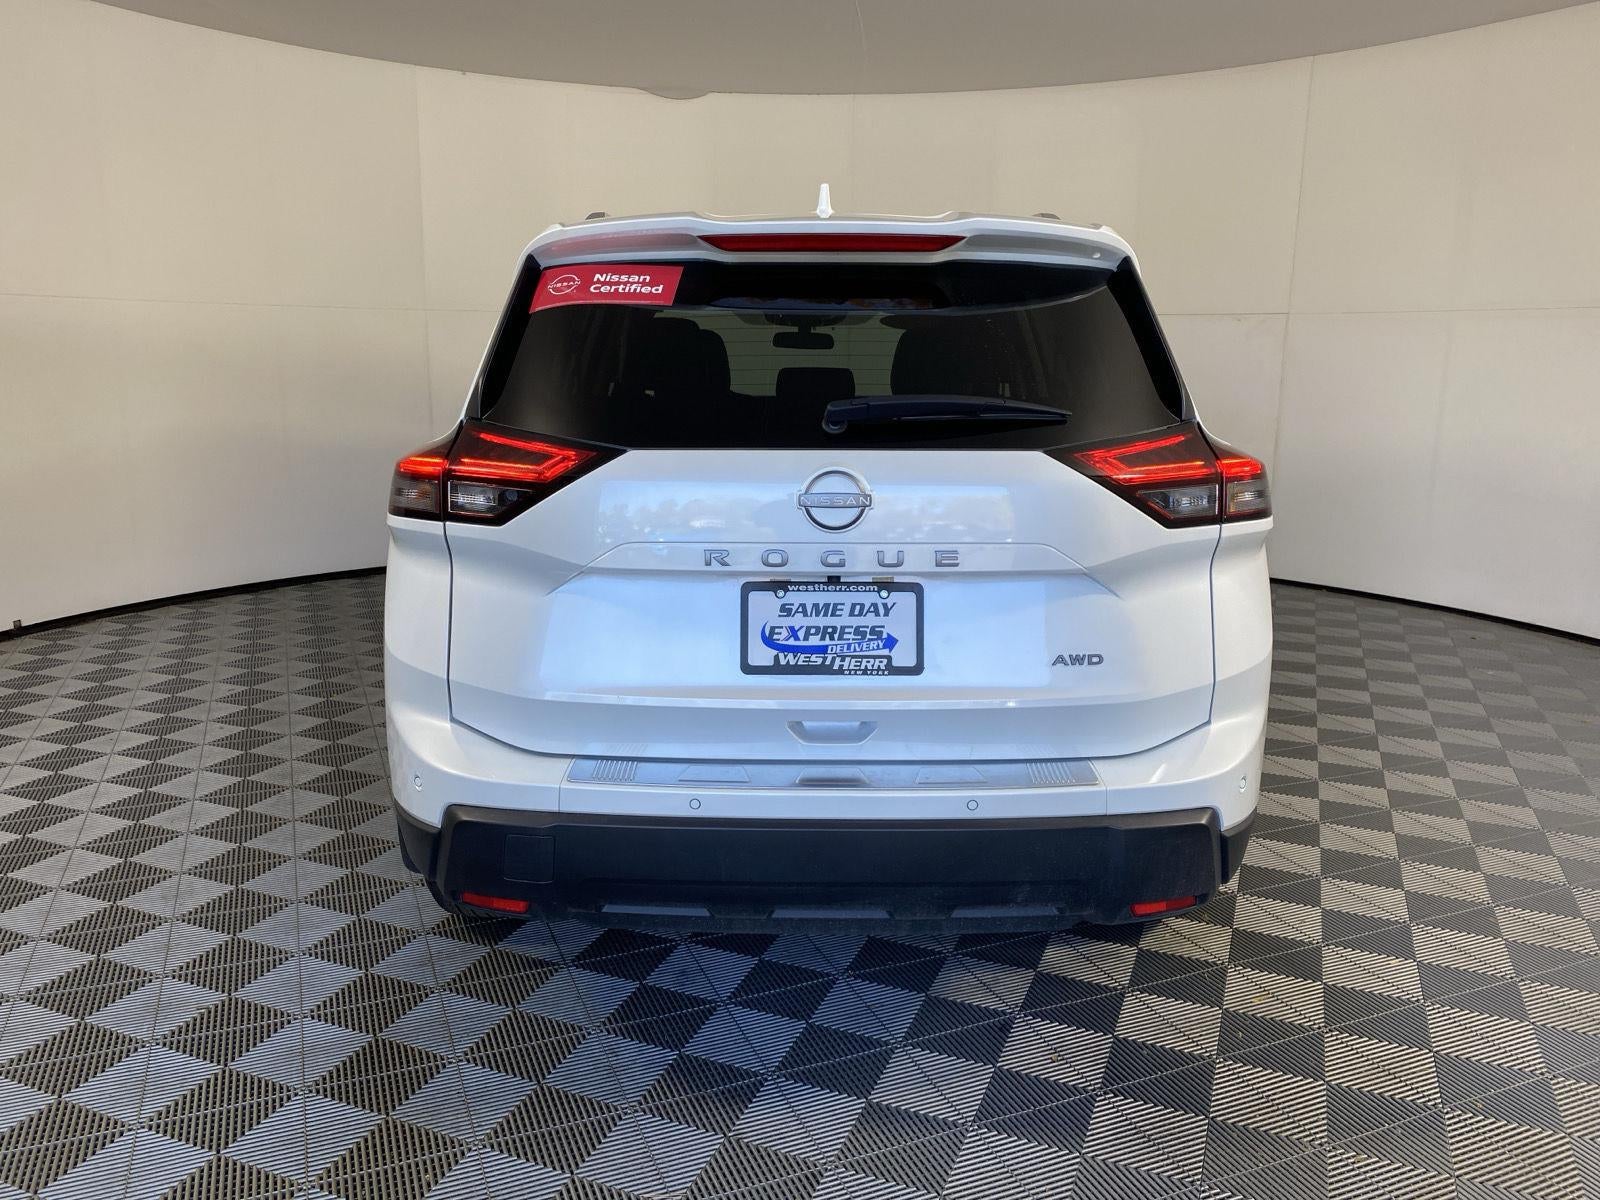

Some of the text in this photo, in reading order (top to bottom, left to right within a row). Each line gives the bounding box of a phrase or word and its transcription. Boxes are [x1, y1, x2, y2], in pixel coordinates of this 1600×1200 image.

[593, 273, 650, 282] Nissan
[548, 279, 581, 290] NISSAN
[589, 284, 664, 294] Certified
[799, 496, 872, 505] NISSAN
[703, 549, 960, 568] ROGUE
[787, 583, 878, 592] westherr.com
[777, 602, 897, 618] SAME DAY
[767, 625, 886, 641] EXPRESS
[827, 640, 886, 654] DELIVERY
[1051, 653, 1104, 666] AWD
